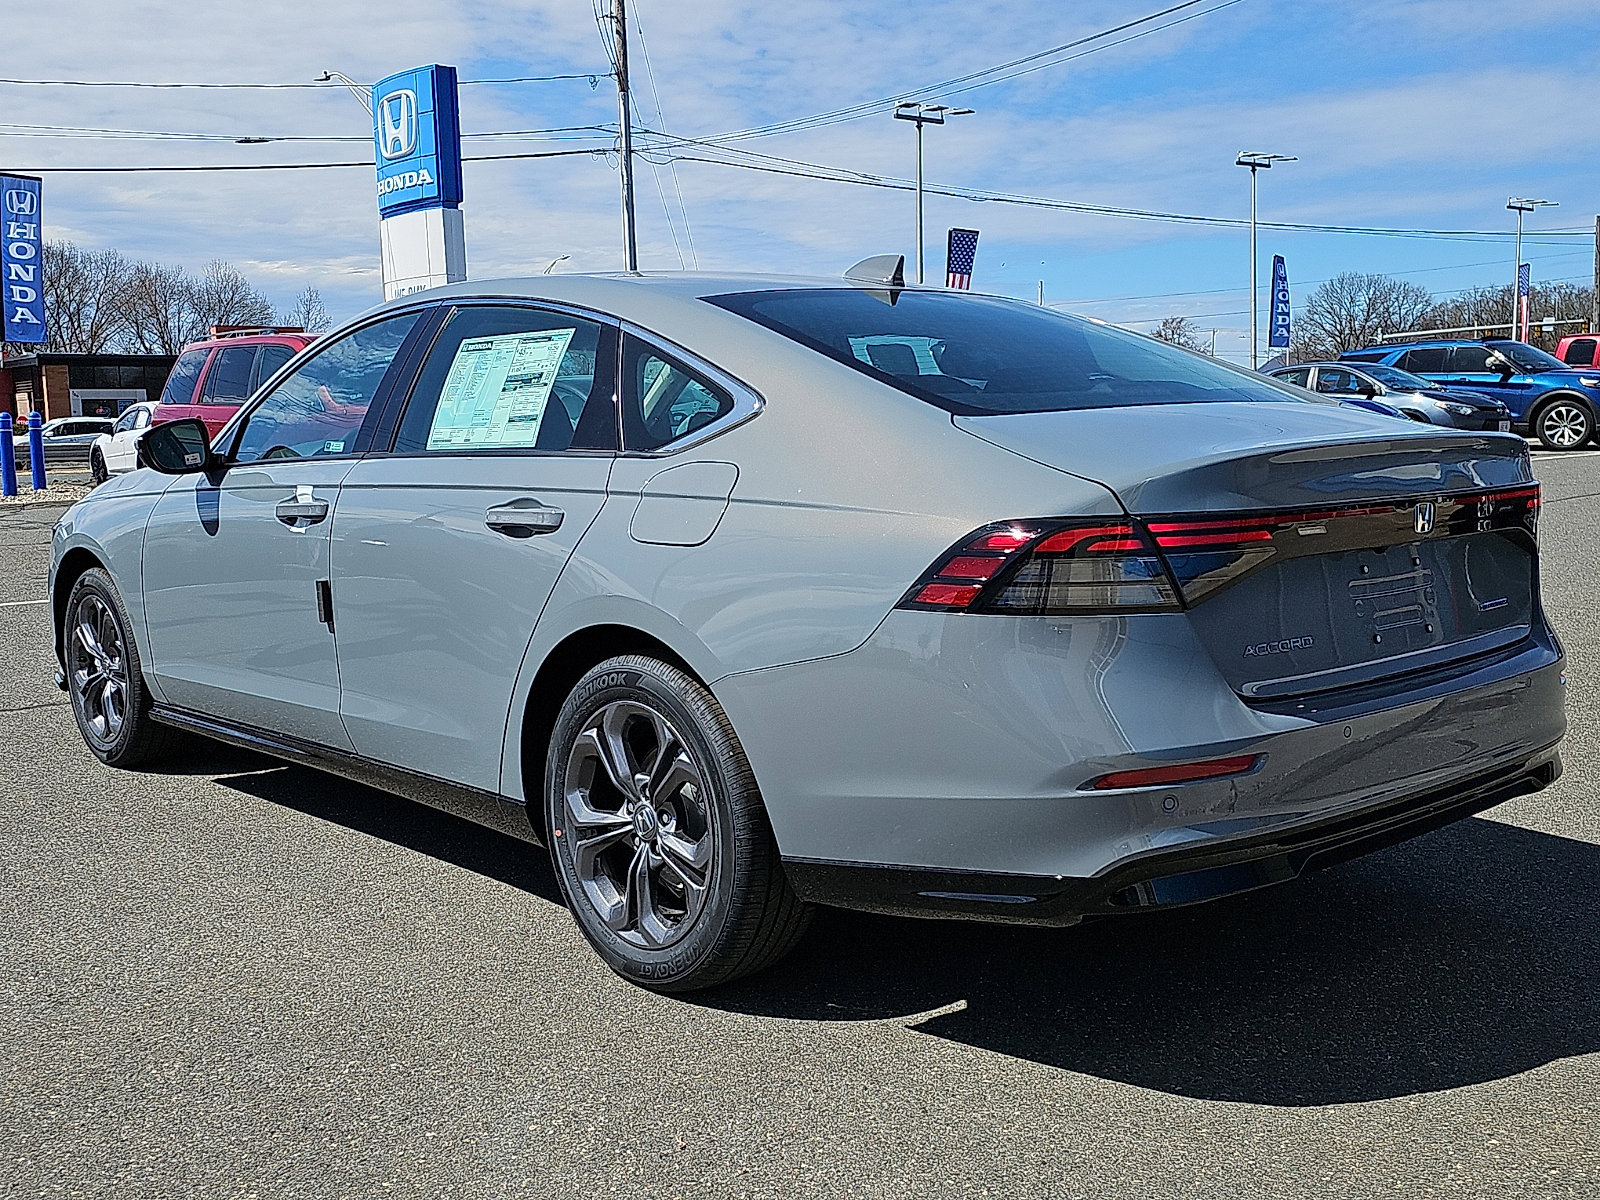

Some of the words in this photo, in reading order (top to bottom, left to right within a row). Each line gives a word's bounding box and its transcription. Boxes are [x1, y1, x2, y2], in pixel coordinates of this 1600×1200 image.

[377, 168, 434, 195] HONDA
[7, 221, 41, 324] HONDA
[1274, 280, 1290, 337] HONDA
[1243, 636, 1314, 658] ACCORD
